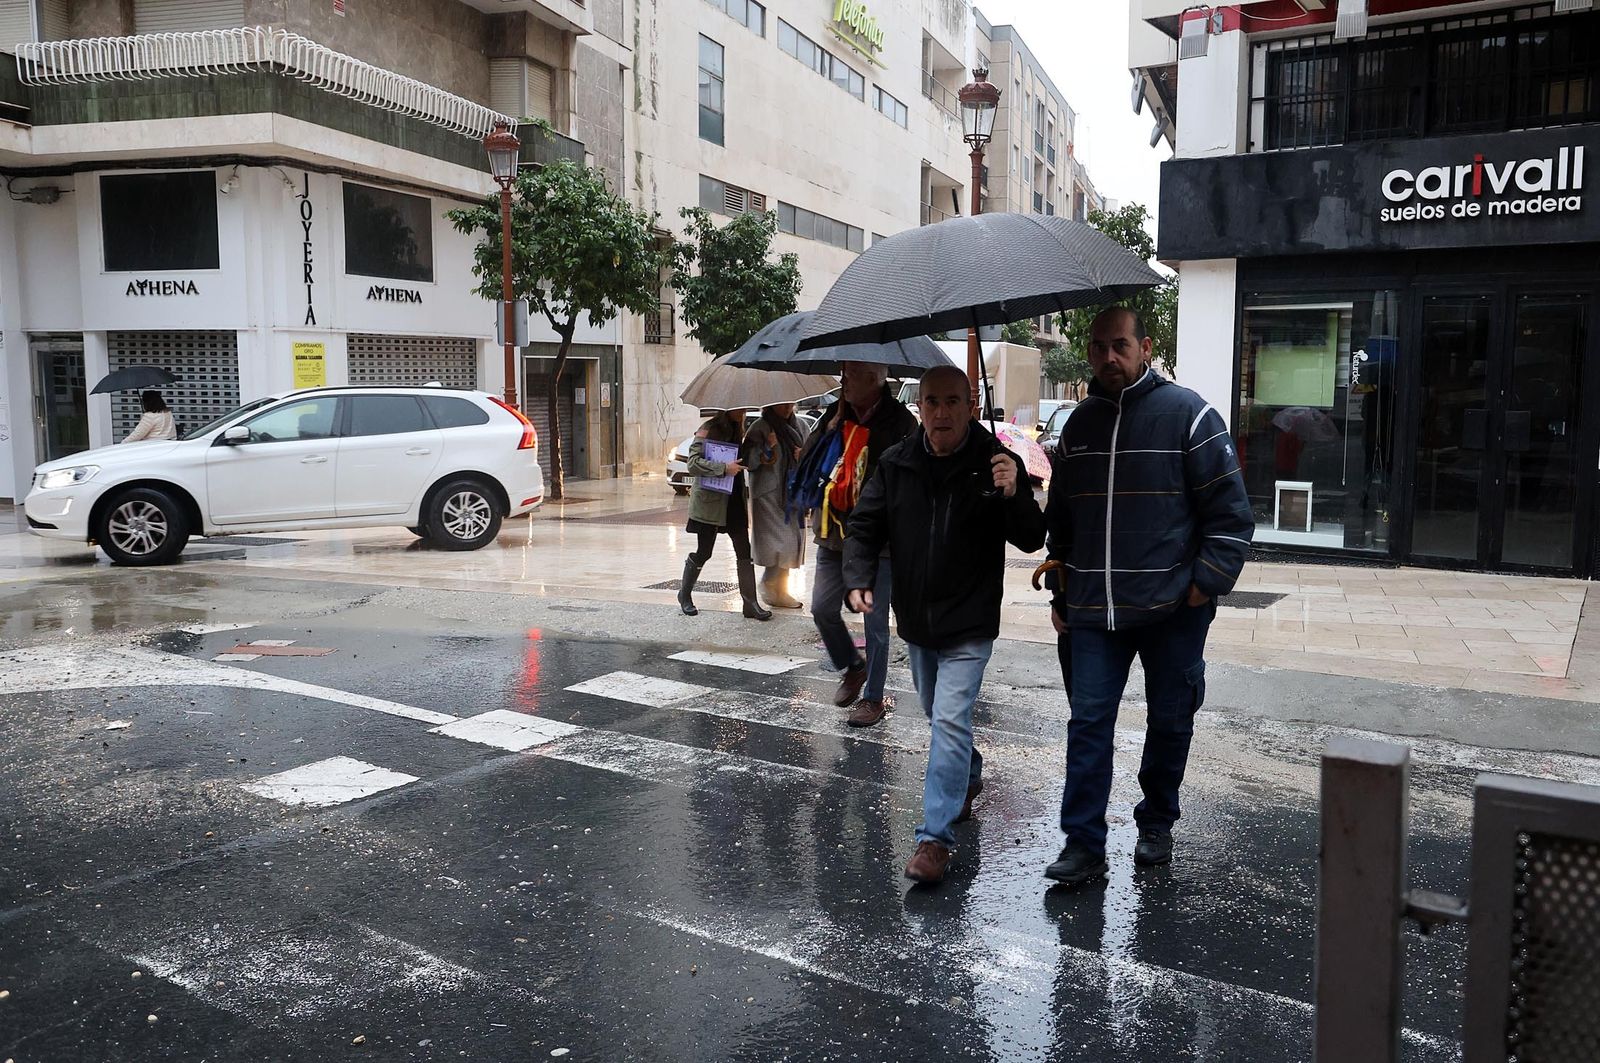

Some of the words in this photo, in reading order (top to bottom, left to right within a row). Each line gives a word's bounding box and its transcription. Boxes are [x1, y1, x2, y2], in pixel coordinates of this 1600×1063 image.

[1381, 146, 1584, 202] carivall
[1380, 203, 1445, 222] suelos
[1451, 199, 1481, 218] de
[1488, 195, 1582, 216] madera
[300, 172, 317, 326] JOYERIA
[126, 279, 199, 297] ATHENA
[366, 285, 423, 304] ATHENA
